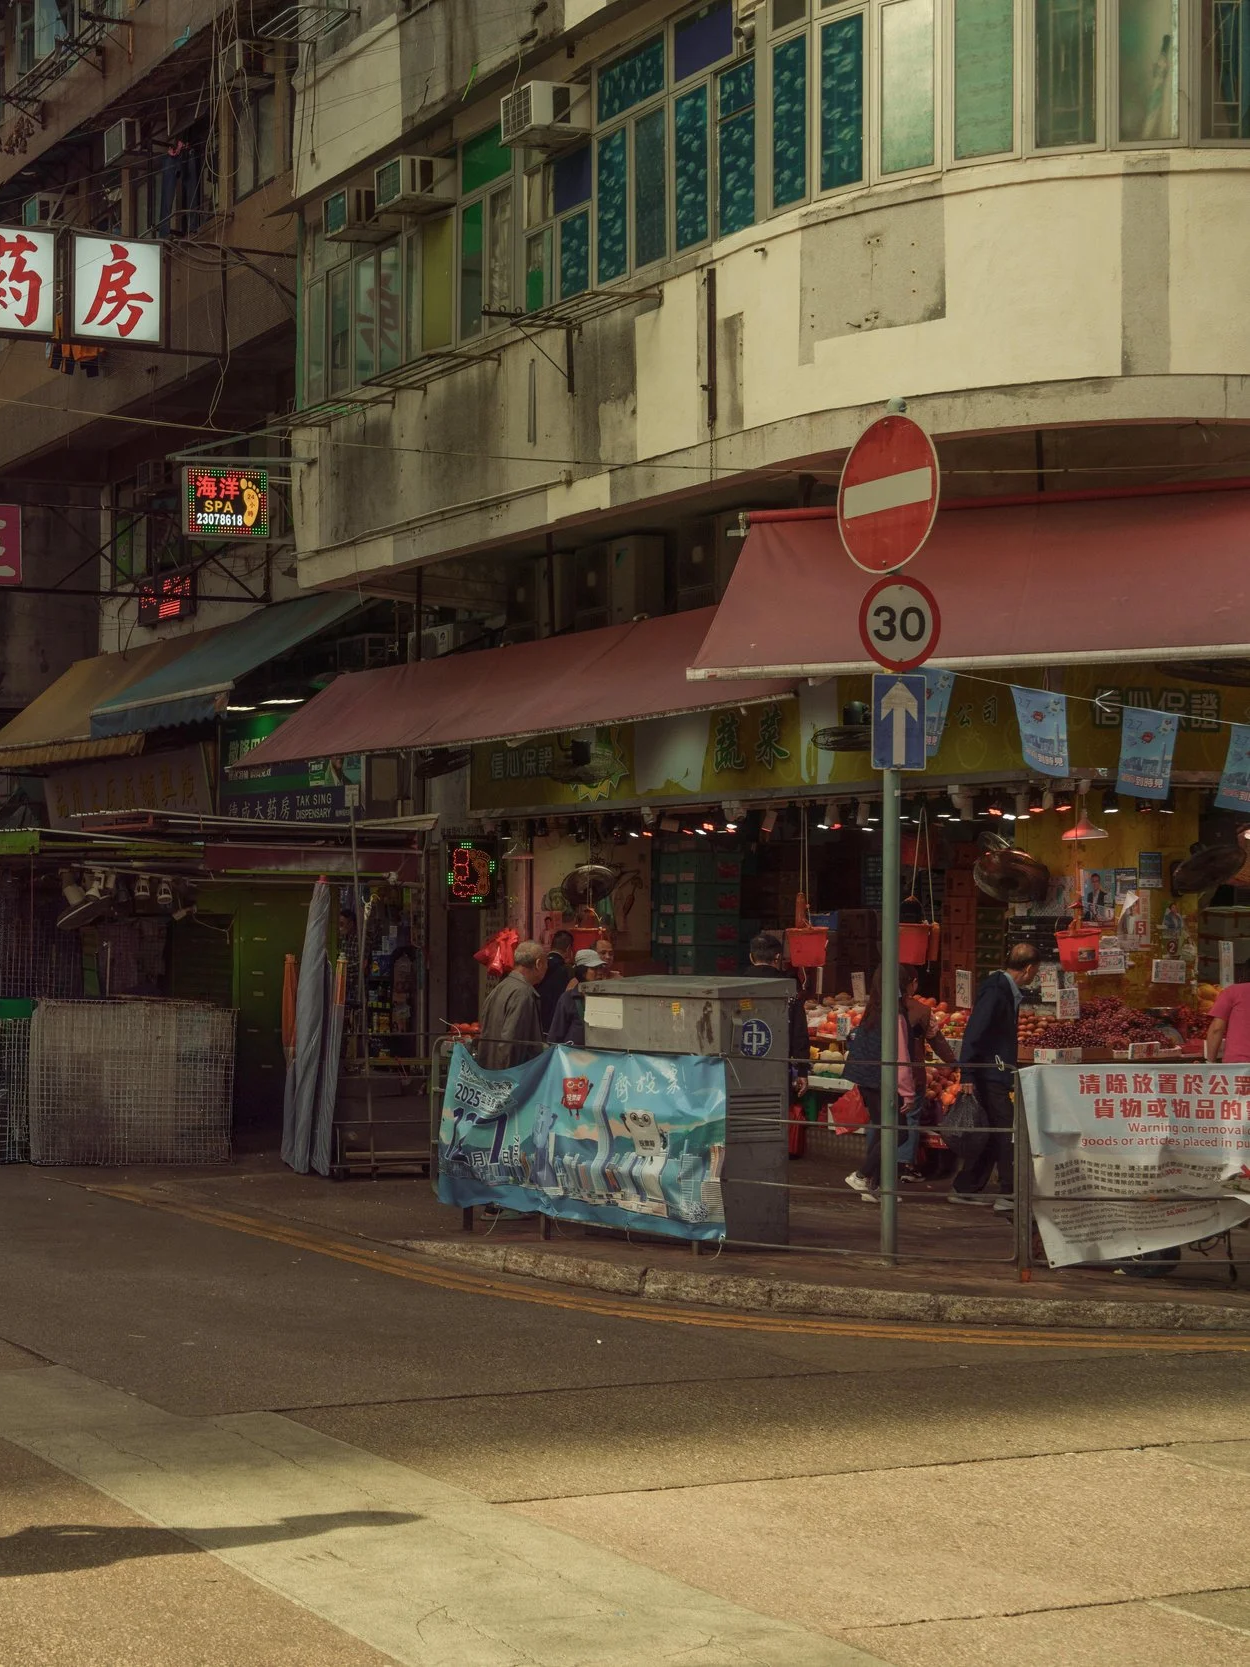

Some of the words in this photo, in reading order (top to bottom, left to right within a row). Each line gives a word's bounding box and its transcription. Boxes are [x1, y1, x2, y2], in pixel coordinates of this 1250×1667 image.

[196, 476, 240, 500] 海洋
[204, 500, 235, 514] SPA
[196, 513, 243, 527] 23078618
[872, 605, 926, 642] 30
[714, 702, 791, 774] 蔬菜
[296, 795, 310, 806] TAK
[313, 793, 332, 804] SING
[295, 807, 331, 820] DISPENSARY
[1137, 922, 1145, 935] 5
[1168, 942, 1176, 954] 2
[1093, 1098, 1250, 1120] 貨物或物品的
[1128, 1123, 1179, 1135] Warning
[1182, 1125, 1194, 1133] on
[1198, 1125, 1245, 1134] removal
[1082, 1136, 1118, 1147] goods
[1121, 1138, 1133, 1146] or
[1137, 1136, 1181, 1147] articles
[1183, 1136, 1218, 1149] placed
[1221, 1138, 1232, 1147] in
